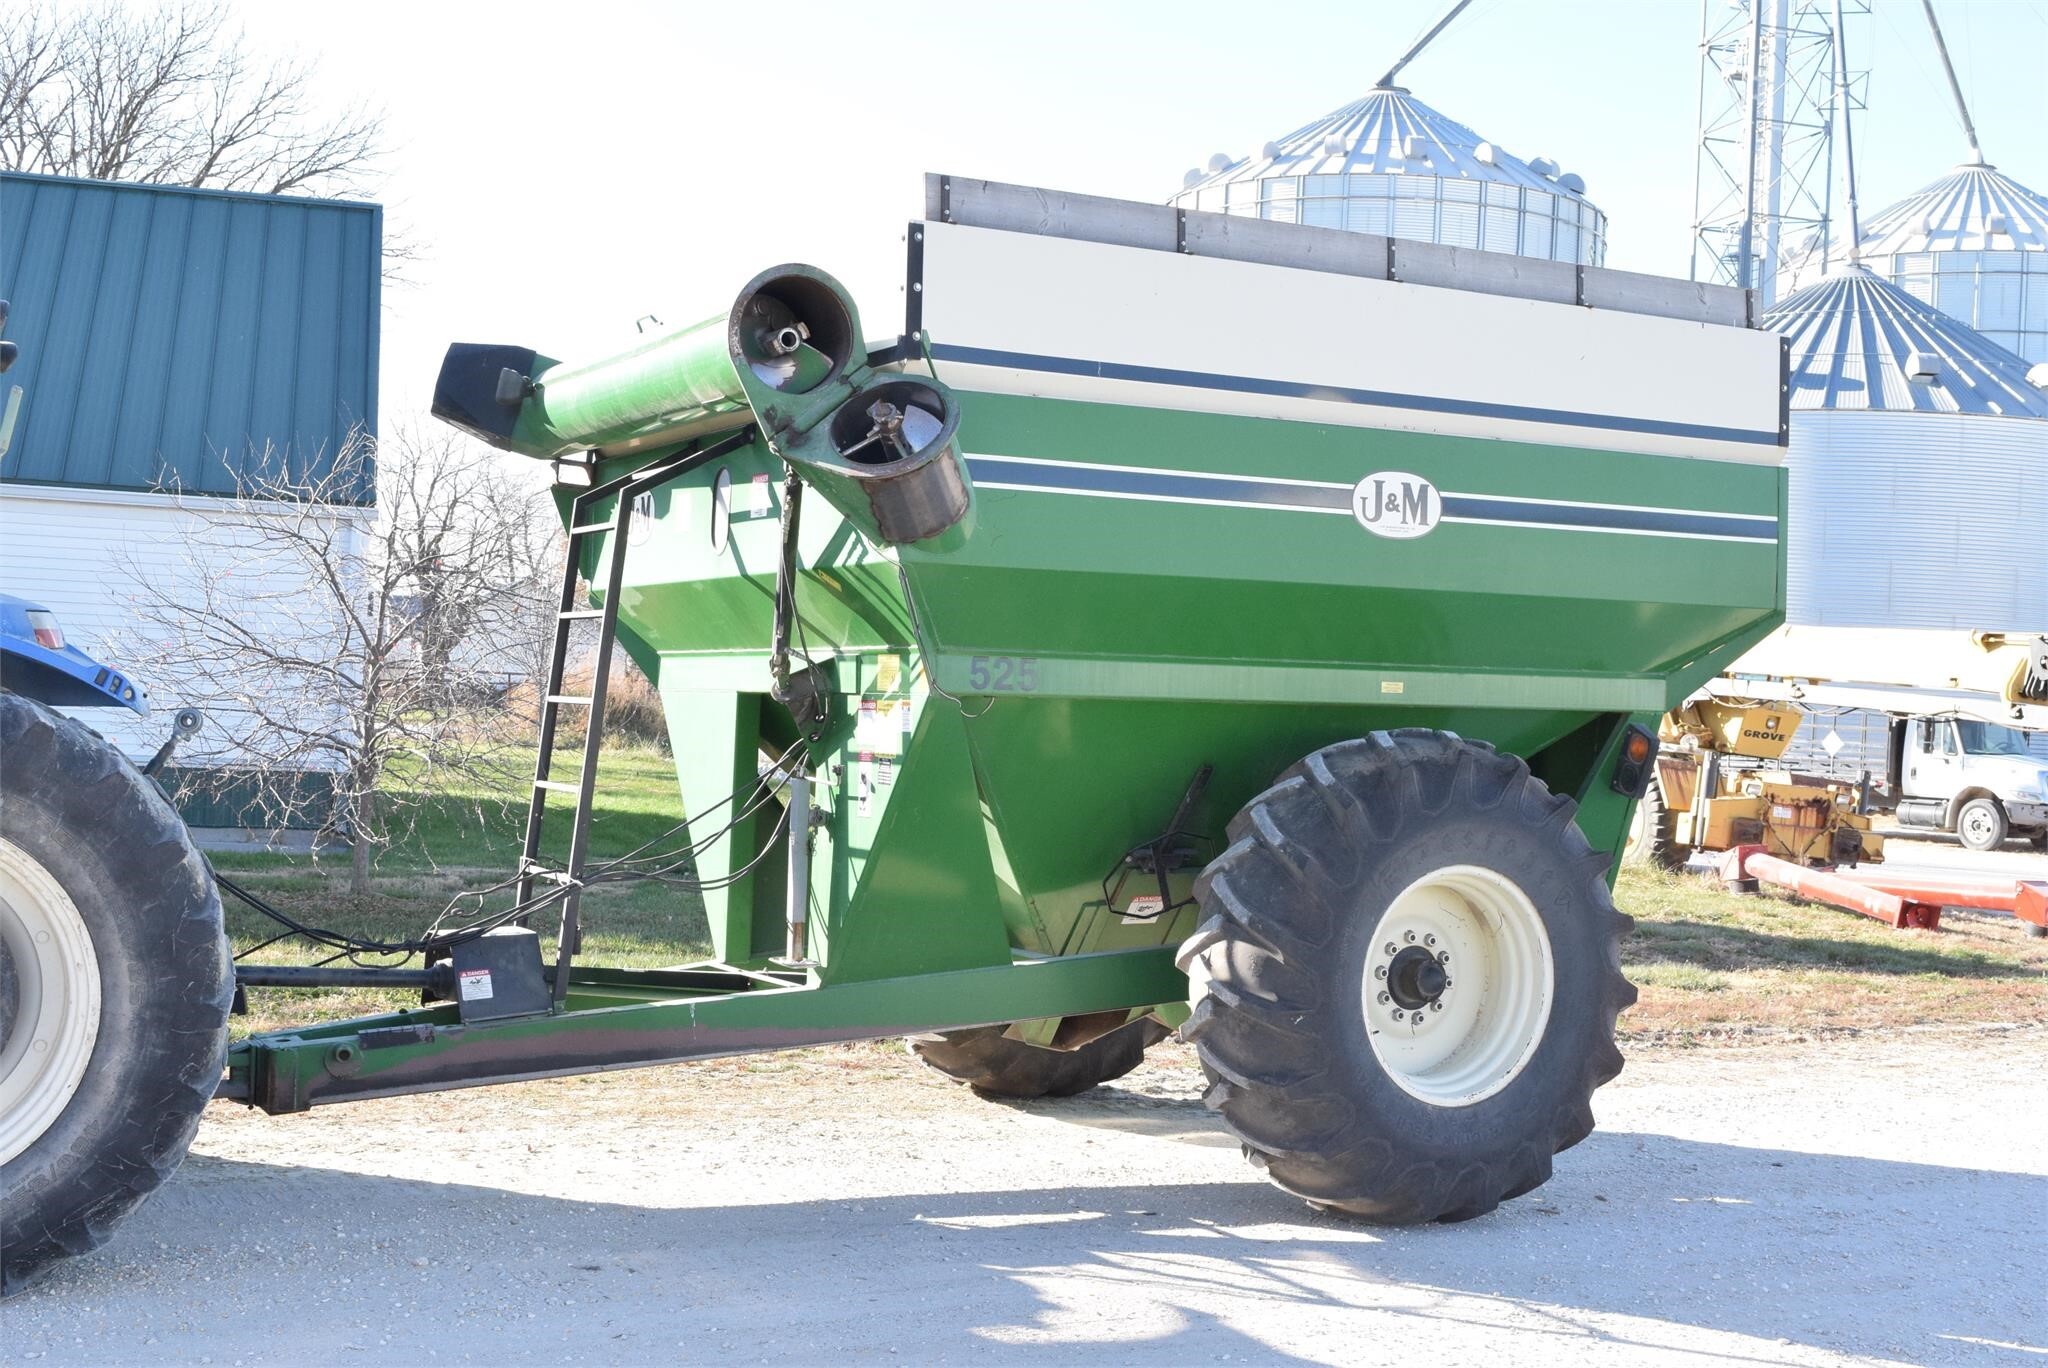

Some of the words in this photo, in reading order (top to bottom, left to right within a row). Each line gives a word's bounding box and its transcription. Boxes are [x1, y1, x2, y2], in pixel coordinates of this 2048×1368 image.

[1360, 479, 1430, 526] J&M
[970, 655, 1038, 692] 525
[1743, 729, 1785, 741] GROVE
